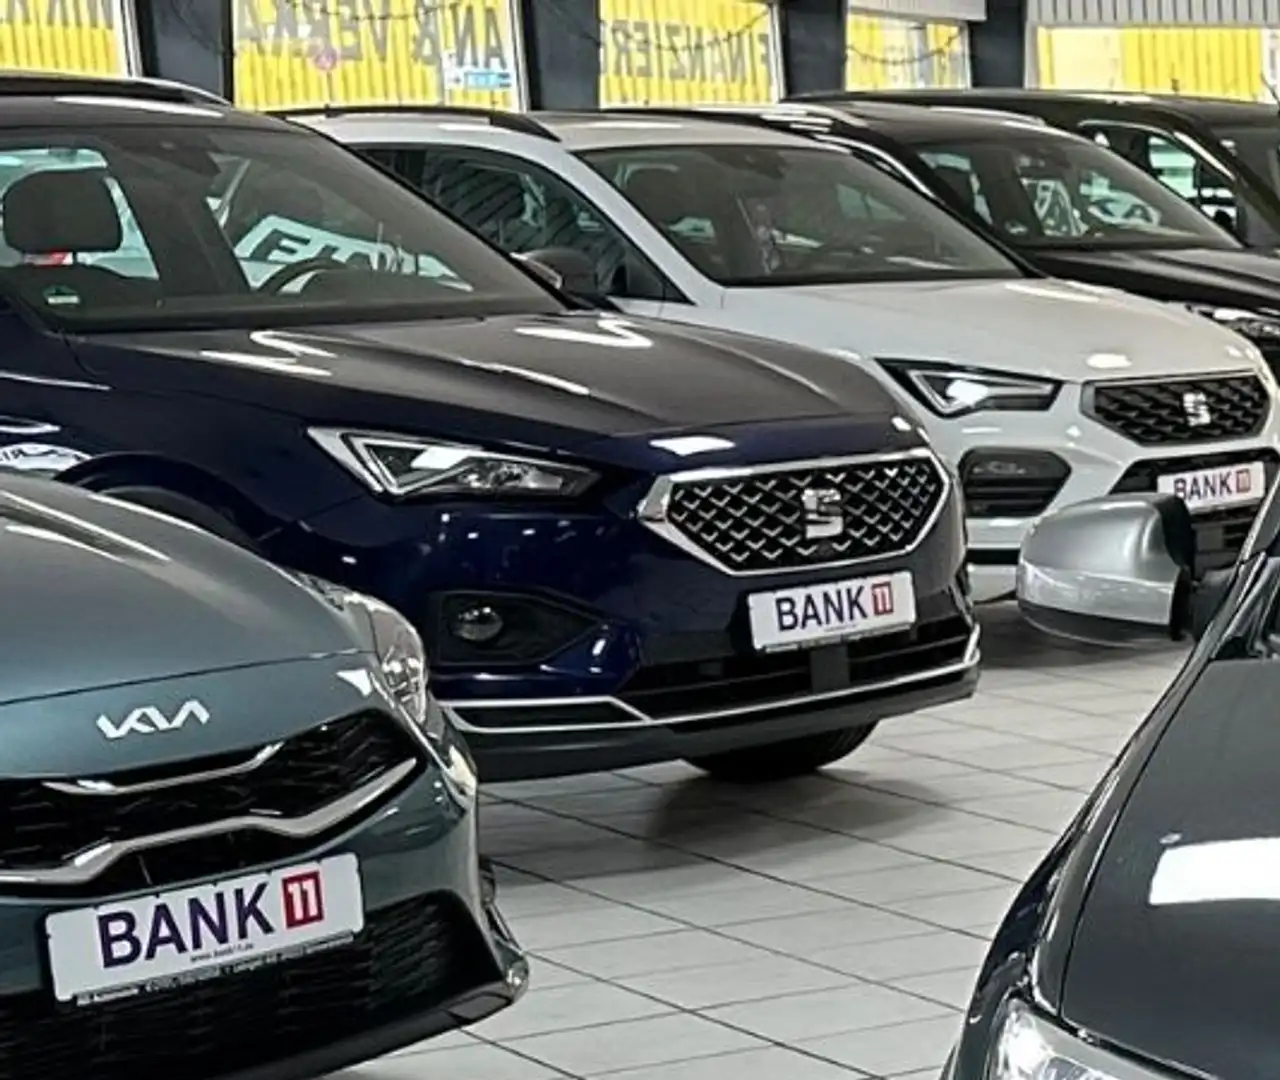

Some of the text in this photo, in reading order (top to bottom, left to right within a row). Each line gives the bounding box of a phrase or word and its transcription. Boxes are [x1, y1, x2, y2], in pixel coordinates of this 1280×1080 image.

[1174, 470, 1232, 501] BANK
[776, 586, 867, 631] BANK
[96, 700, 209, 740] KIA
[97, 884, 274, 968] BANK
[287, 873, 320, 922] 11
